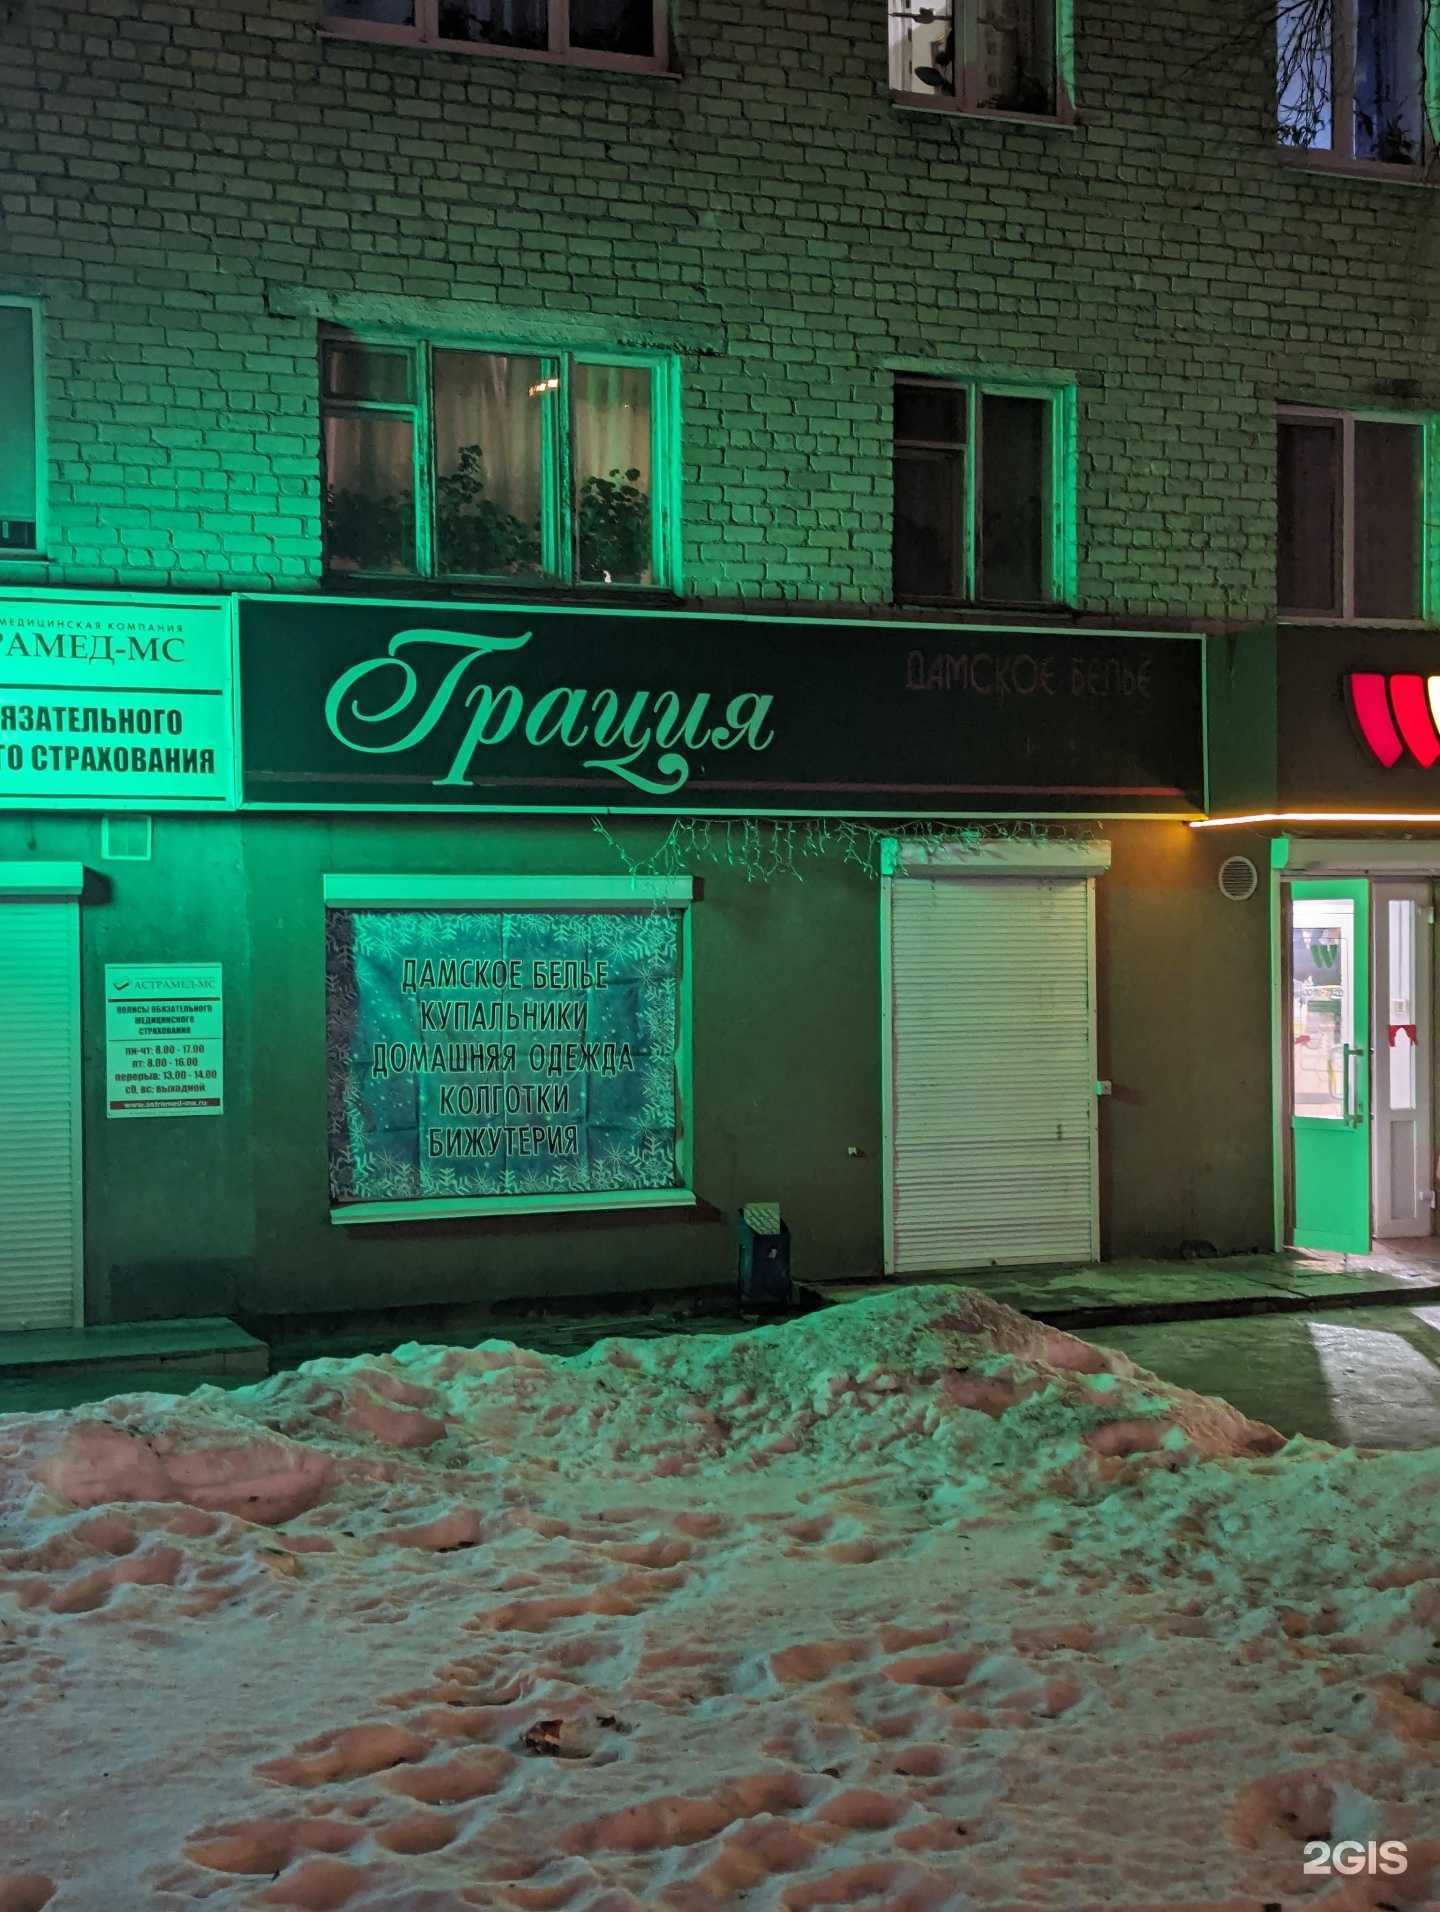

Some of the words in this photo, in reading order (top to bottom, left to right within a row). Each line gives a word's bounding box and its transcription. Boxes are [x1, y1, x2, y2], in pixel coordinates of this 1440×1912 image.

[108, 622, 184, 633] КОМПАНИЯ
[905, 650, 1056, 697] ДАМСКОЕ
[0, 705, 183, 736] ЯЗАТЕЛЬНОГО
[325, 628, 775, 794] Грация
[31, 744, 215, 775] СТРАХОВАНИЯ
[401, 959, 524, 993] ДАМСКОЕ
[532, 960, 609, 991] БЕЛЬЕ
[420, 1000, 589, 1031] КУПАЛЬНИКИ
[371, 1042, 517, 1078] ДОМАШНЯЯ
[528, 1042, 635, 1077] ОДЕЖДА
[439, 1084, 569, 1115] КОЛГОТКИ
[428, 1125, 579, 1158] БИЖУТЕРИЯ
